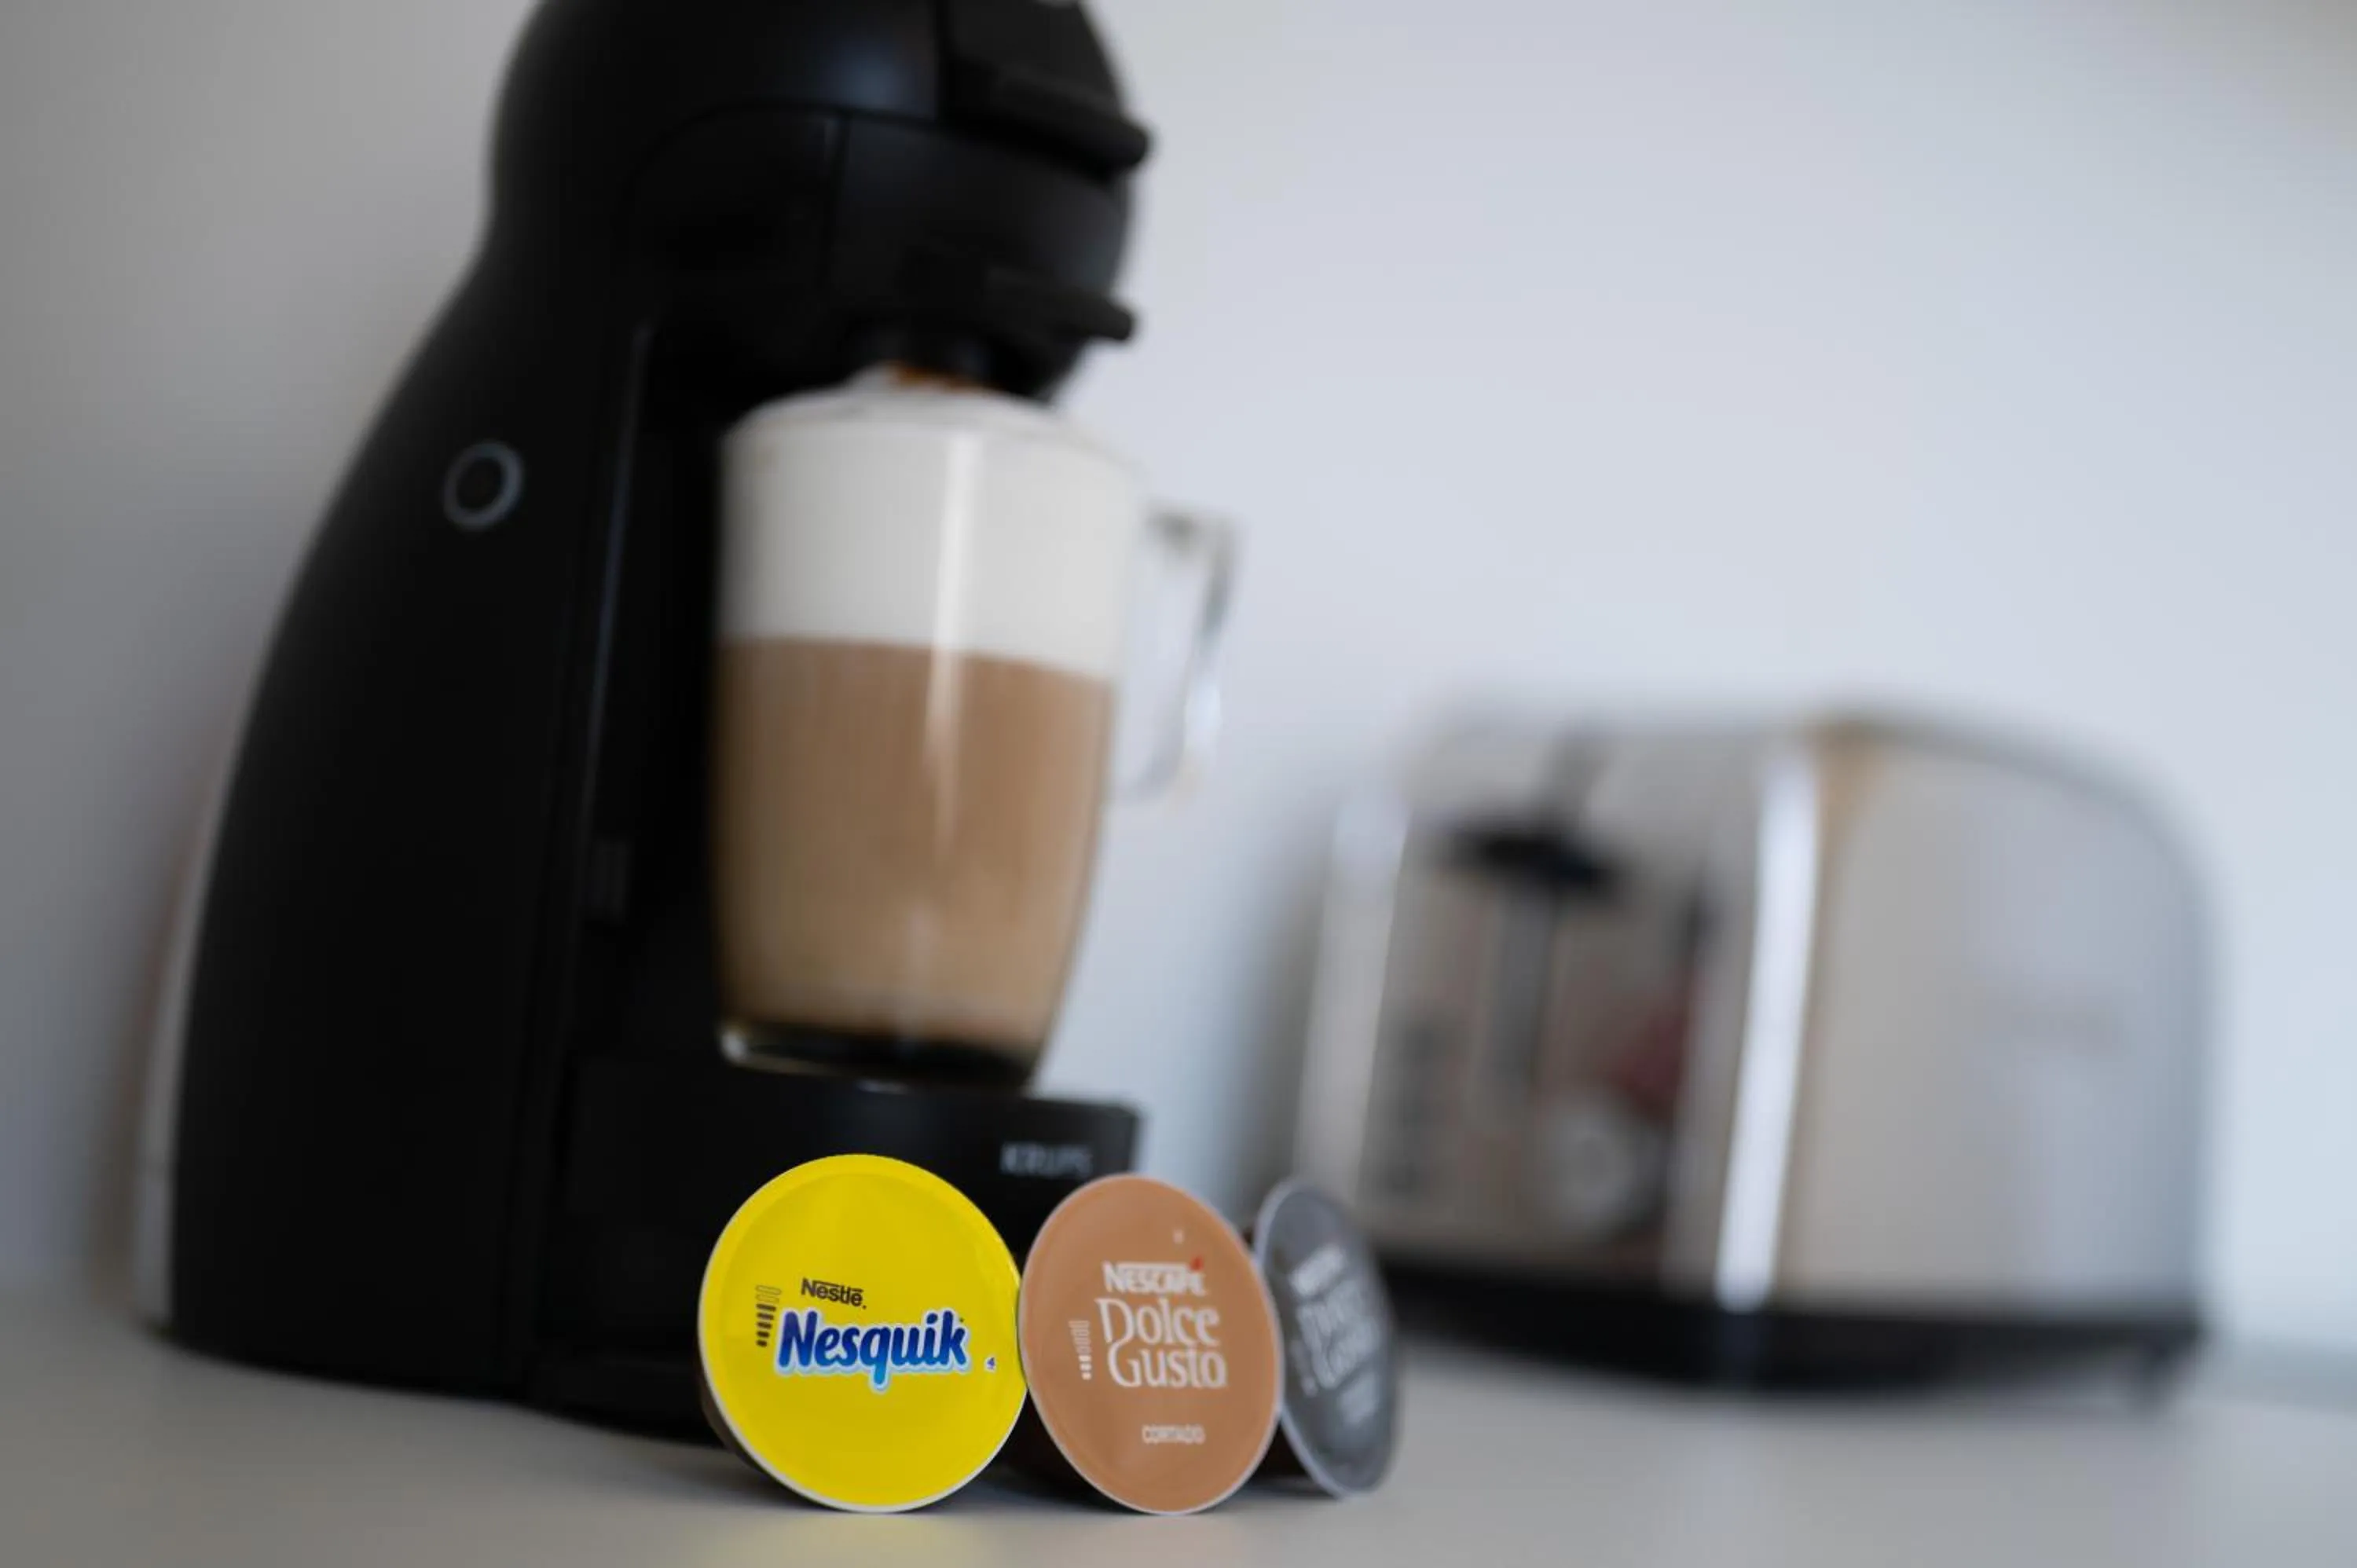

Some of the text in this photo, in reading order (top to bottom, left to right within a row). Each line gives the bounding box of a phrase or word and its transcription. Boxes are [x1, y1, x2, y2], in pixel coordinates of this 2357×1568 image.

[1095, 1297, 1221, 1346] Dolce
[776, 1308, 970, 1390] Nesquik
[1107, 1339, 1228, 1389] Gusto
